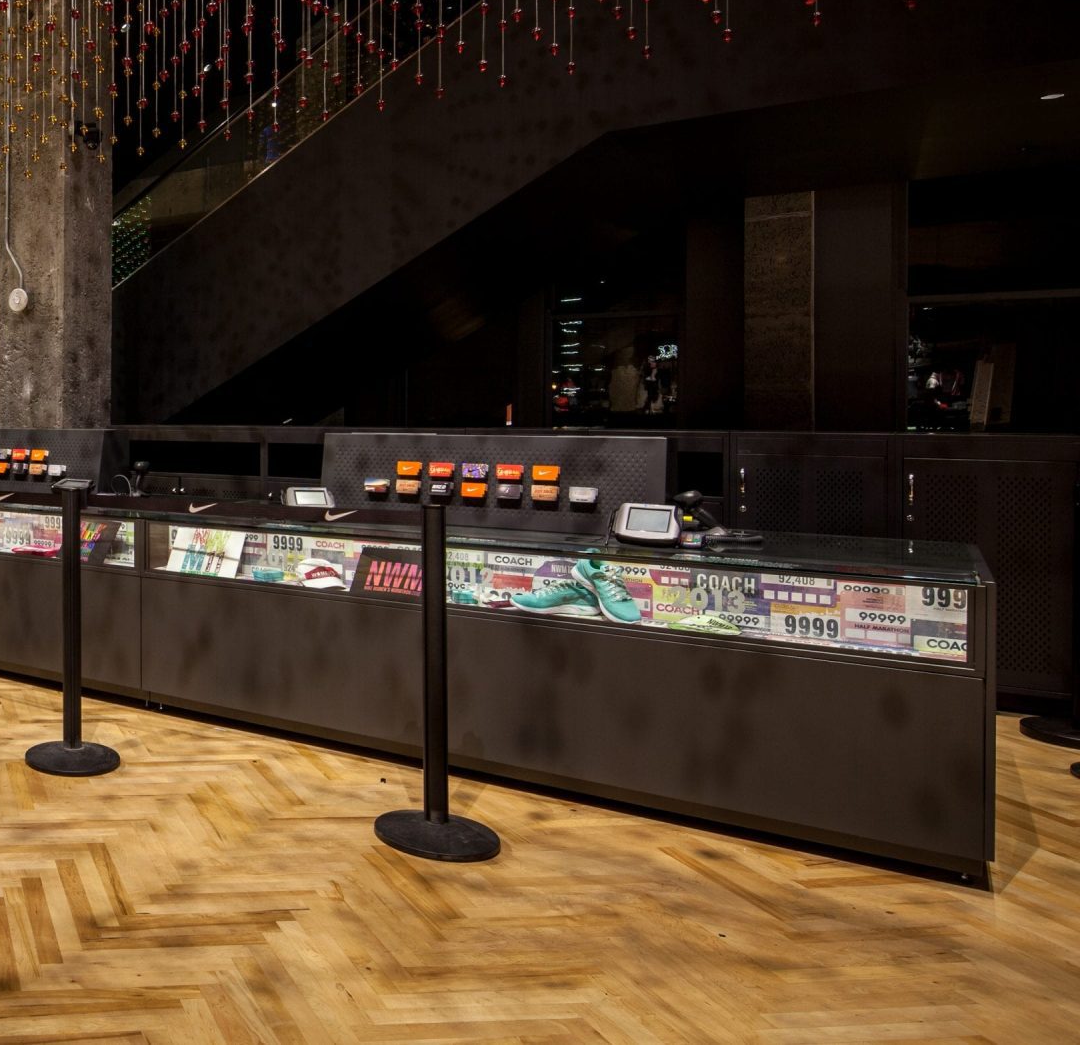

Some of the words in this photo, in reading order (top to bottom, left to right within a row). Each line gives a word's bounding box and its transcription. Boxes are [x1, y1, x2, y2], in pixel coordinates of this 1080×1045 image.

[272, 534, 304, 552] 9999
[315, 540, 345, 550] COACH
[493, 555, 533, 567] COACH
[696, 573, 756, 595] COACH
[656, 603, 700, 616] COACH
[858, 611, 906, 625] 99999
[784, 615, 839, 639] 9999
[854, 623, 871, 631] HALF
[871, 625, 910, 634] MARATHON
